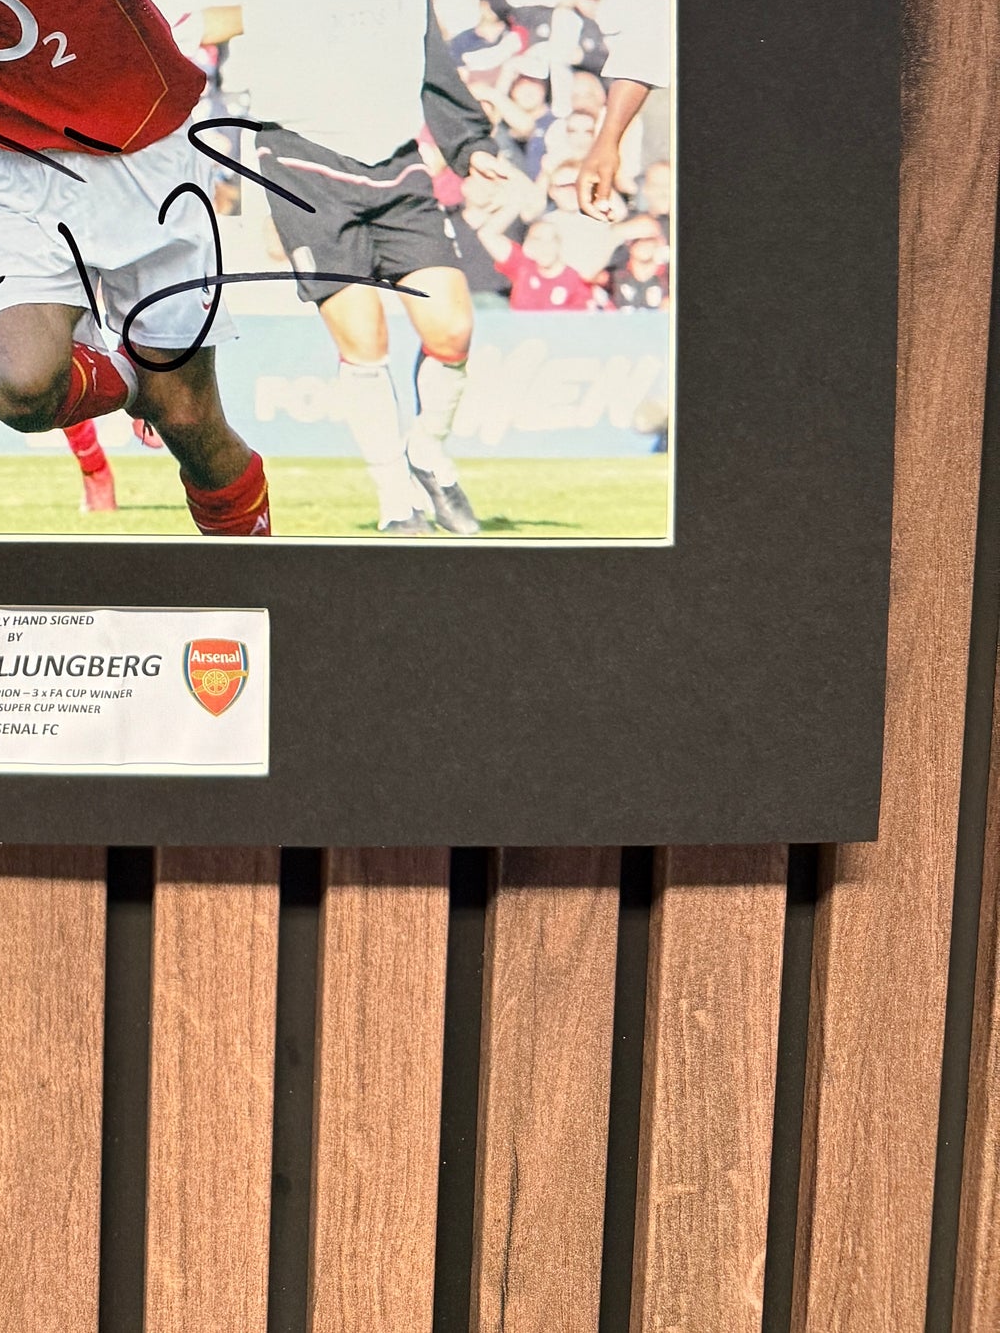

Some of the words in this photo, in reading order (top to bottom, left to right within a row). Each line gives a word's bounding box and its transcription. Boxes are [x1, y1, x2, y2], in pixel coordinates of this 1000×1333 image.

[12, 615, 48, 626] HAND
[49, 615, 95, 626] SIGNED
[7, 632, 23, 643] BY
[190, 649, 241, 664] Arsenal
[32, 688, 39, 697] 3
[49, 688, 63, 698] FA
[65, 688, 87, 698] CUP
[90, 689, 133, 699] WINNER
[33, 703, 55, 712] CUP
[57, 704, 101, 714] WINNER
[42, 723, 59, 736] FC
